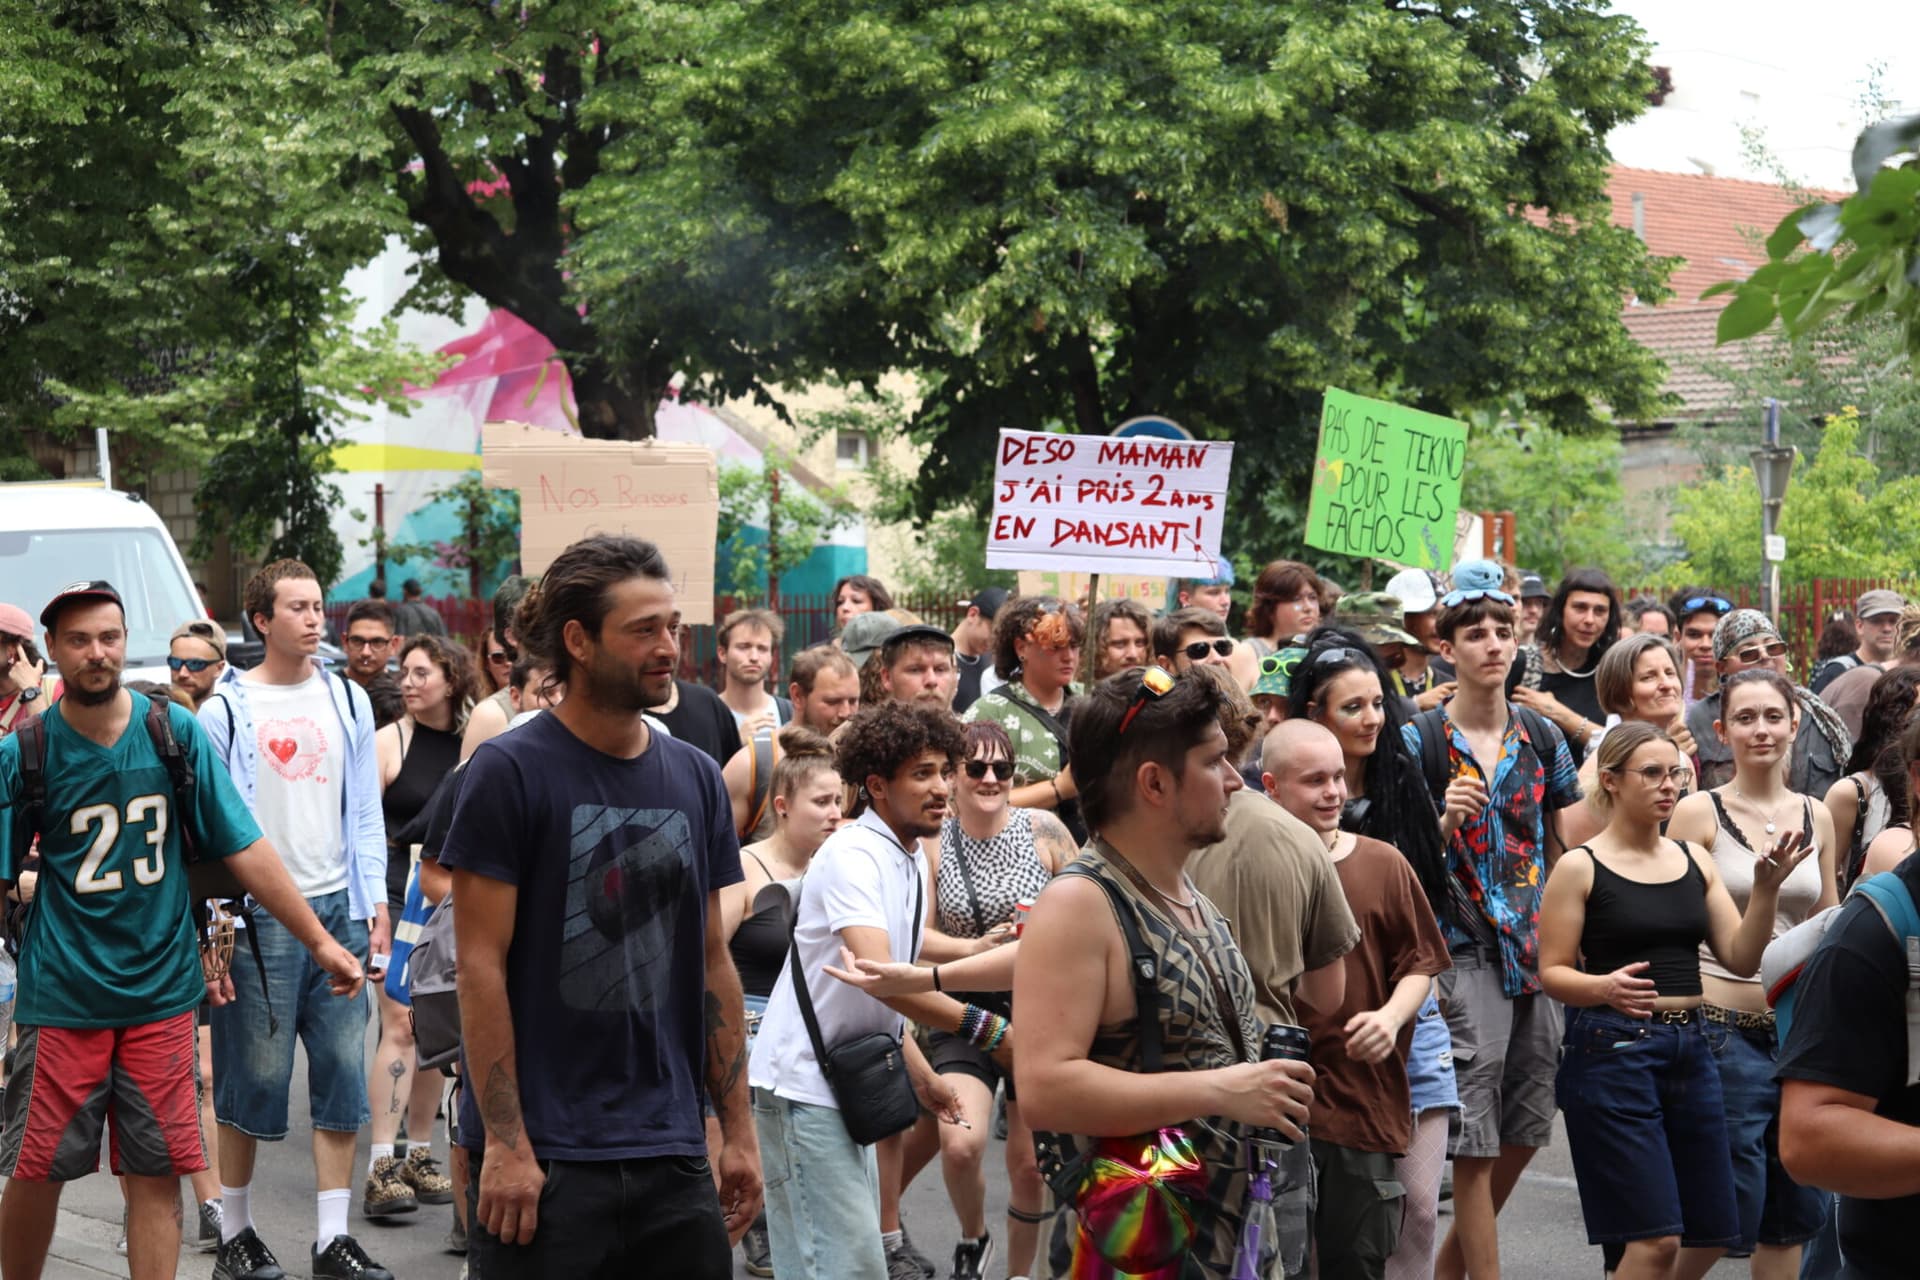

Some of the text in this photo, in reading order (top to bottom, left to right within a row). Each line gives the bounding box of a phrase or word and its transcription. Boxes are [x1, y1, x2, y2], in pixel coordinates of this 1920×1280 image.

[1002, 436, 1210, 470] DESO MAMAN
[1322, 404, 1466, 481] PAS DE TEKNO
[539, 460, 599, 512] Nos
[1339, 462, 1443, 522] POUR LES
[994, 514, 1036, 540] EN
[1325, 502, 1405, 557] FACHOS
[69, 793, 168, 895] 23
